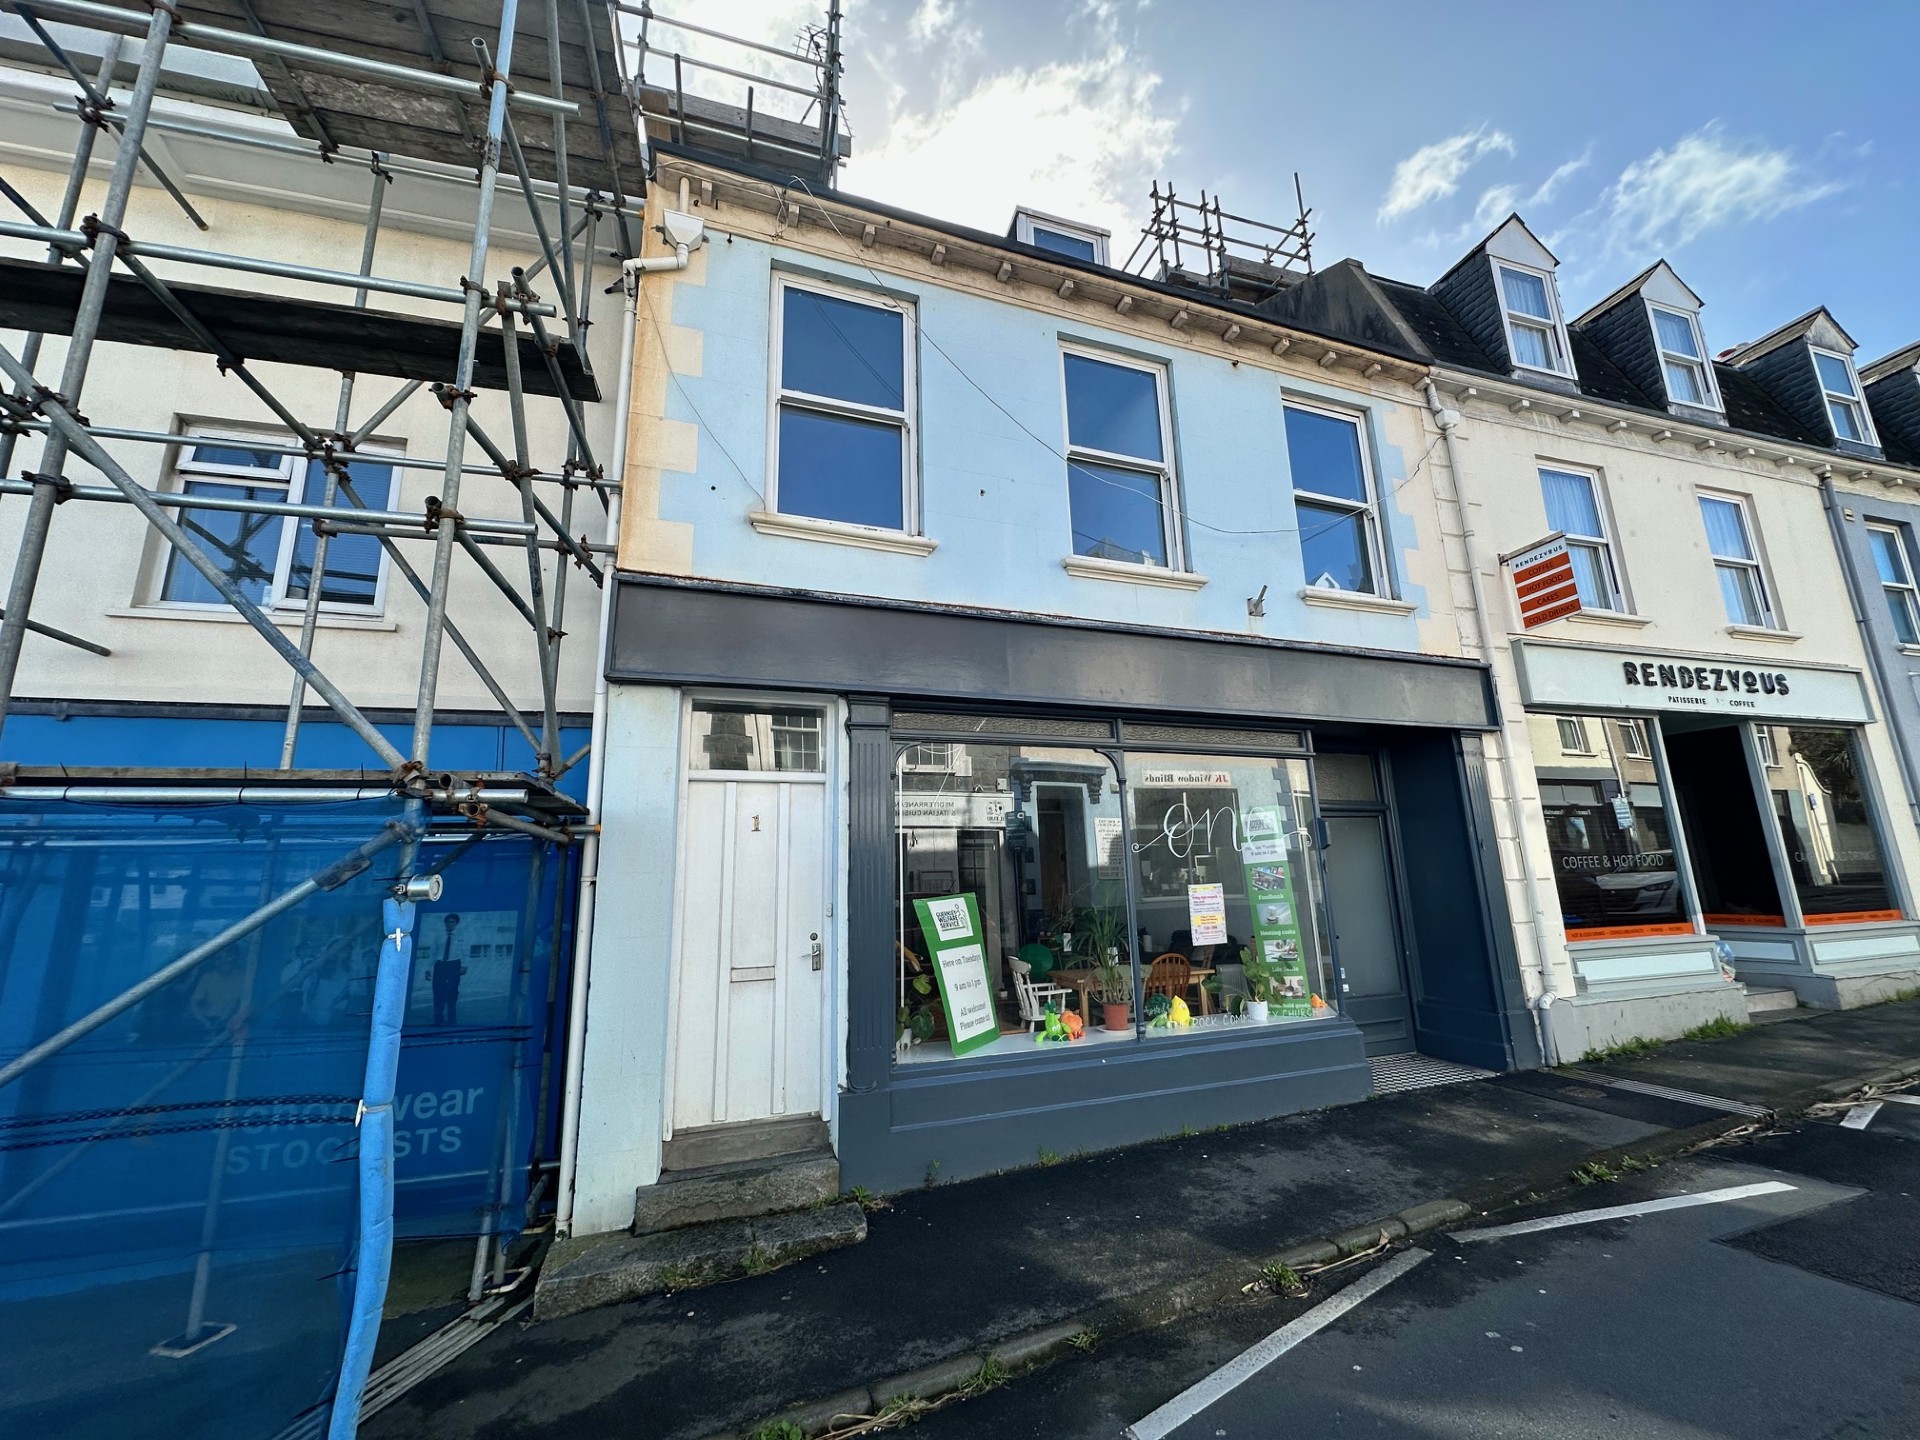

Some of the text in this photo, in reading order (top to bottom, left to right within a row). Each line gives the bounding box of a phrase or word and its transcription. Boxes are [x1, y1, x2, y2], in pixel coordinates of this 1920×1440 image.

[1515, 544, 1563, 569] RENDEZVOUS
[1528, 561, 1554, 577] COFFEE
[1526, 574, 1564, 593] HOT FOOD
[1537, 592, 1560, 606] CAKES
[1528, 603, 1576, 625] COLD DRINKS
[1622, 661, 1790, 696] RENDEZVOUS
[1667, 695, 1707, 706] PATISSERIE
[1729, 699, 1756, 708] COFFEE
[751, 814, 761, 832] 1
[1562, 853, 1664, 869] COFFEE & HOT FOOD
[935, 910, 957, 918] GUERNSEY
[938, 915, 959, 923] WELFARE
[940, 921, 960, 929] SERVICE
[942, 953, 982, 969] Here on Tuesdays
[954, 983, 959, 991] 9
[959, 982, 967, 990] am
[960, 1006, 968, 1017] All
[1192, 1017, 1217, 1029] ROCK
[1282, 1007, 1319, 1018] CHURCH
[960, 1020, 975, 1031] Please
[974, 1017, 985, 1026] come
[226, 1125, 463, 1176] STOCSTS
